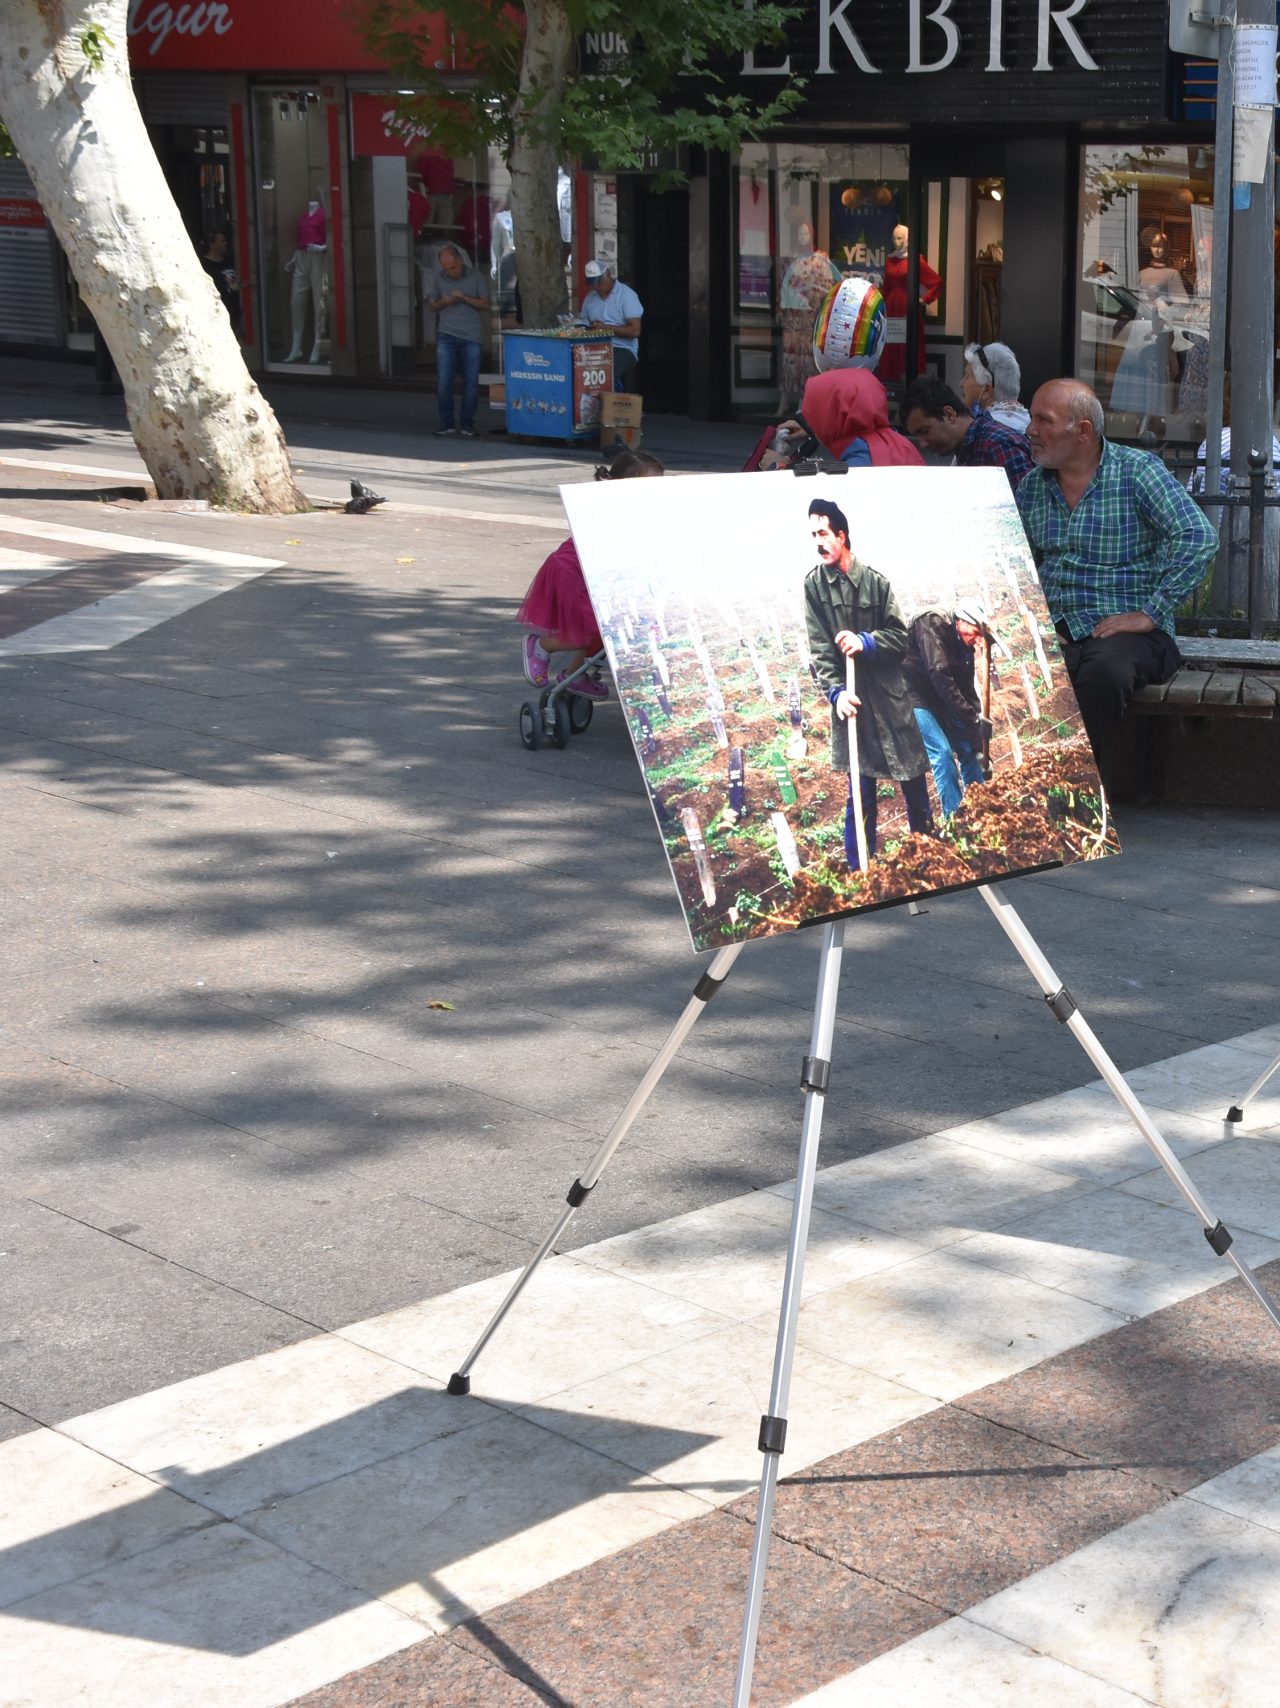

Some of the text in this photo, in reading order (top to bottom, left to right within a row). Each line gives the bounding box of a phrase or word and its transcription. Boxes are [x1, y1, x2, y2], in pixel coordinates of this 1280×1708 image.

[585, 31, 629, 54] NUR
[679, 0, 1100, 76] EKBIR
[583, 370, 606, 386] 200
